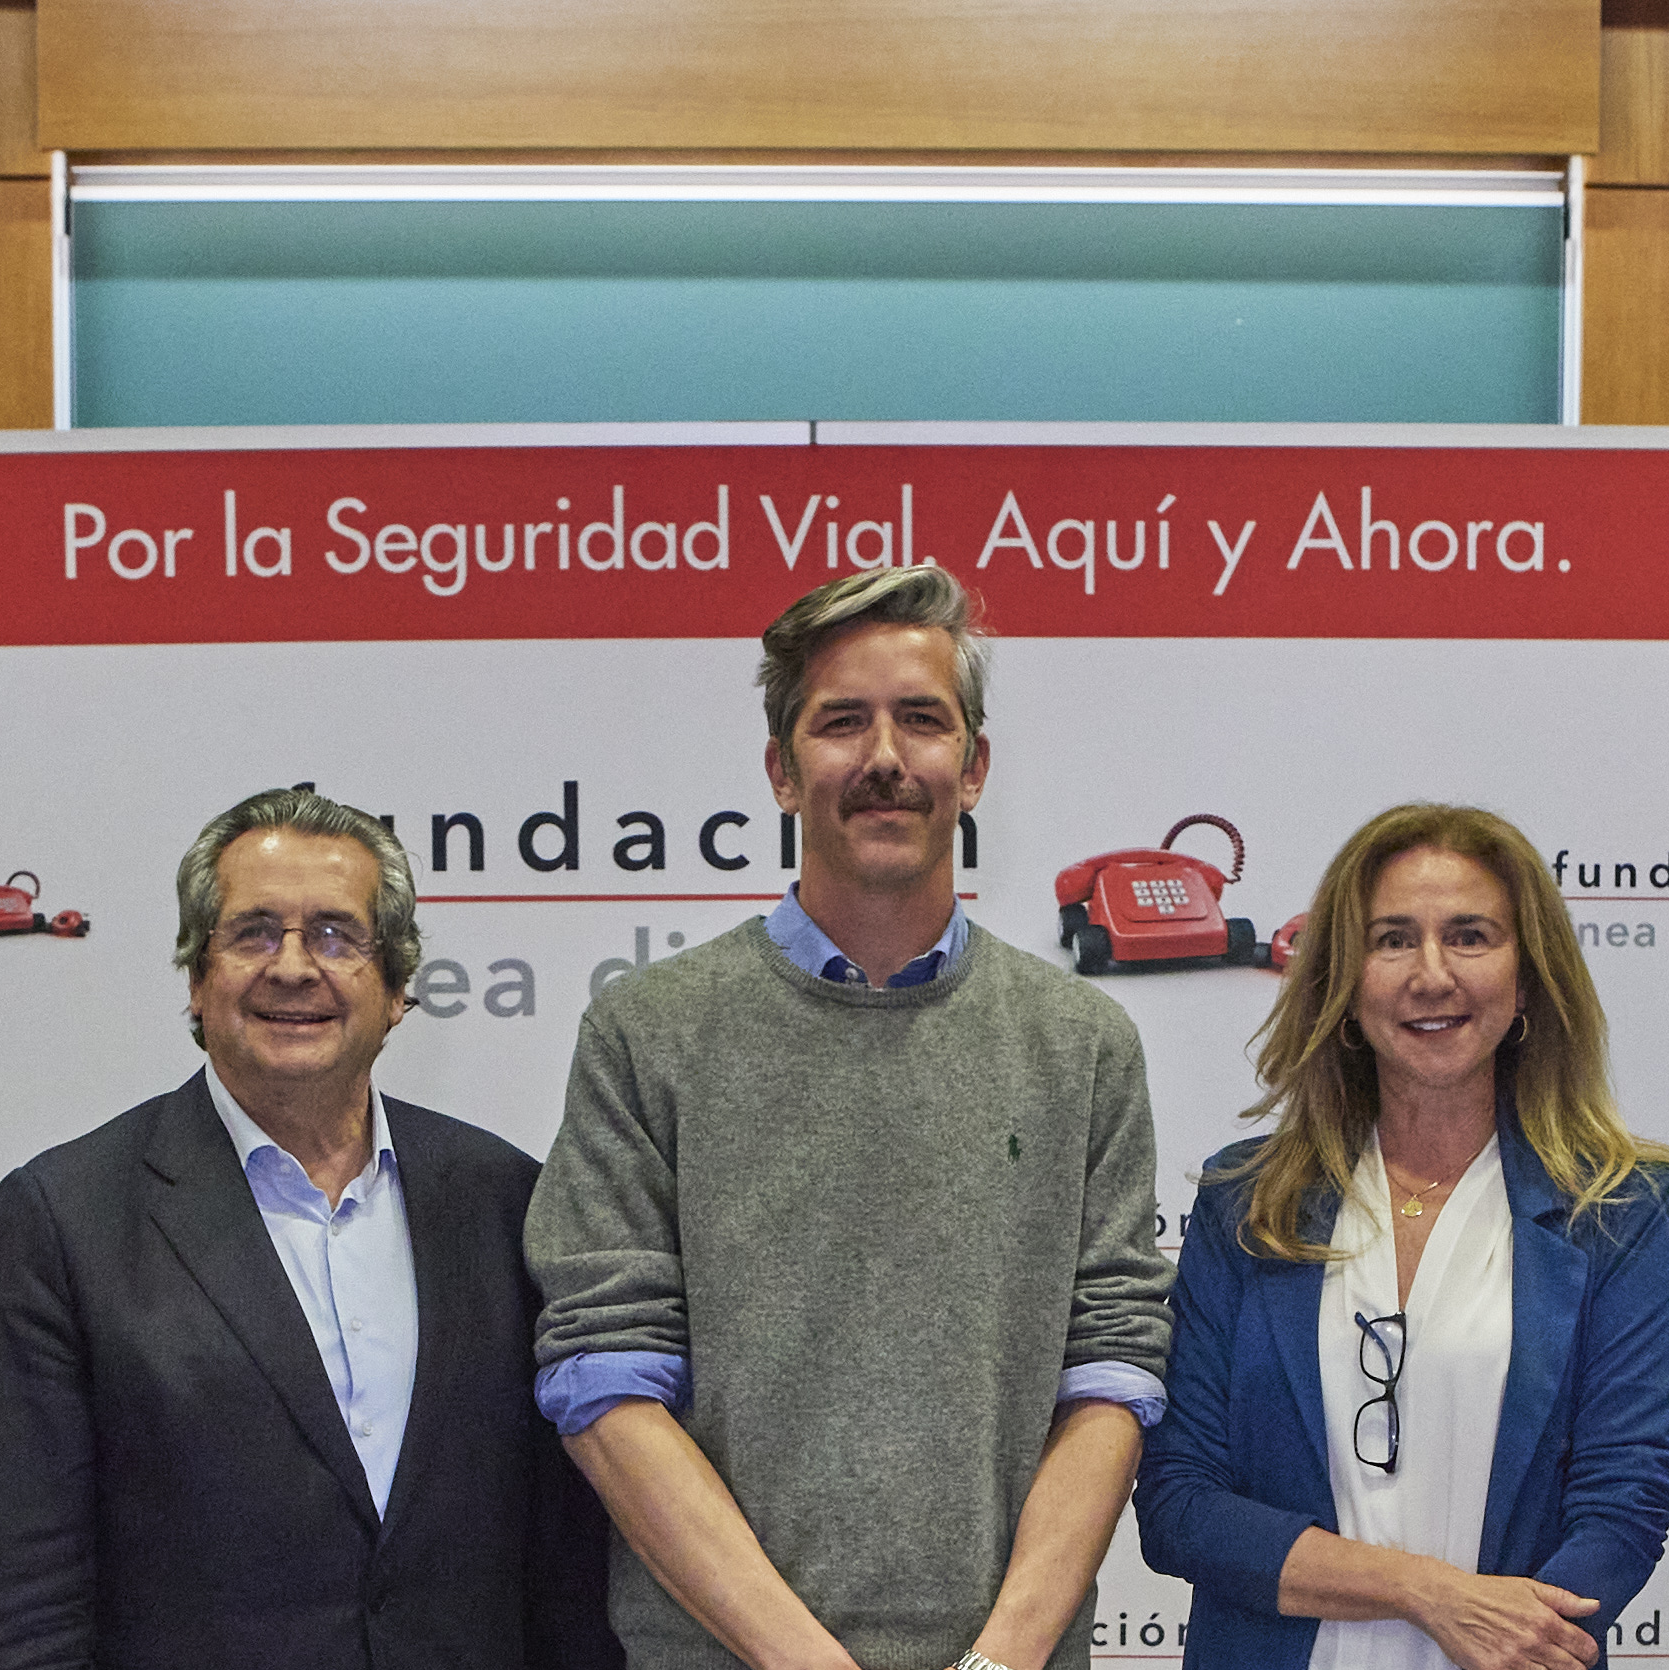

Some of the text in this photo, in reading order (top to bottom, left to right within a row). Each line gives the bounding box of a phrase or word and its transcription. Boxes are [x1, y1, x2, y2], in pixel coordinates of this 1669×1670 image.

[64, 503, 194, 580] Por
[224, 489, 292, 577] la
[325, 484, 730, 596] Seguridad
[976, 490, 1177, 595] Aquí
[1206, 519, 1257, 595] y
[1286, 486, 1573, 572] Ahora.
[1579, 922, 1656, 947] nea
